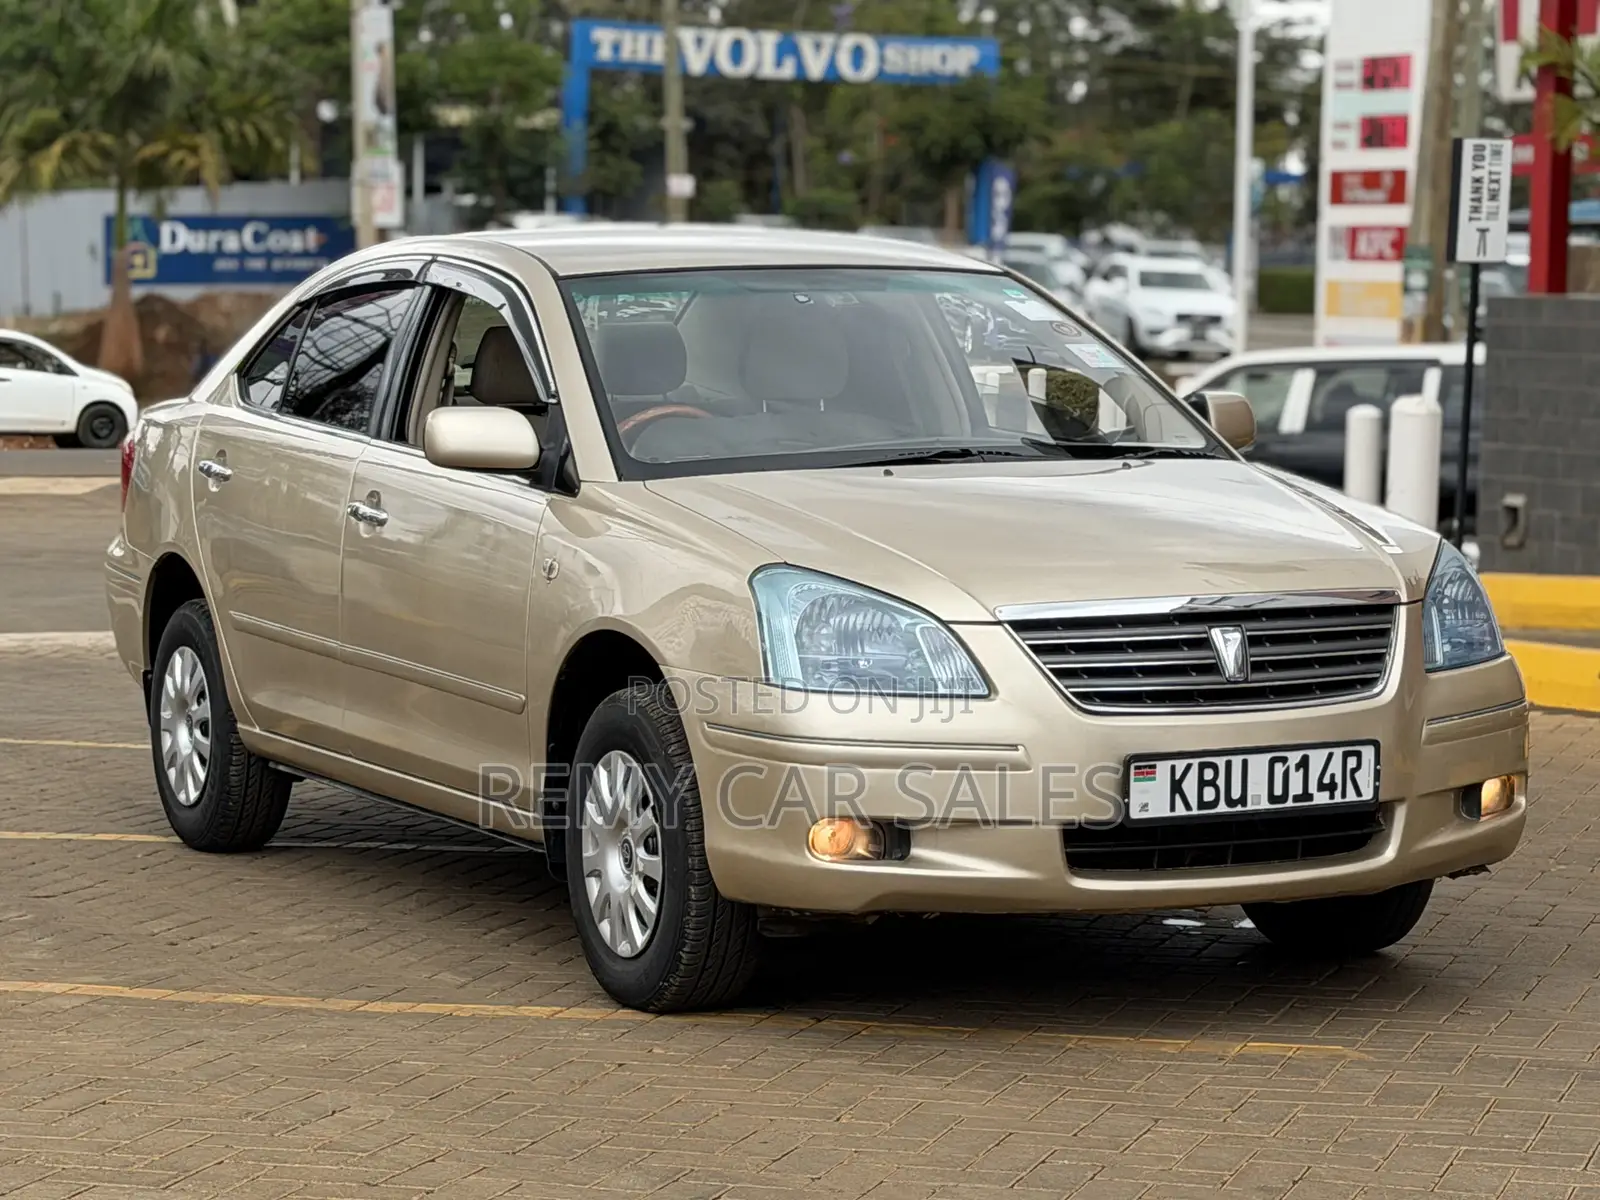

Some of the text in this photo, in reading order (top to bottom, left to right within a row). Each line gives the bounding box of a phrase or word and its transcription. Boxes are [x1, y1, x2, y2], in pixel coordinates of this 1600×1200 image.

[676, 26, 879, 82] VOLVO
[883, 42, 980, 76] SHOP
[1468, 143, 1486, 223] THANK YOU
[1487, 170, 1502, 202] NEXT
[159, 220, 321, 255] DuraCoat
[1169, 758, 1249, 813] KBU
[1267, 749, 1363, 806] 014R
